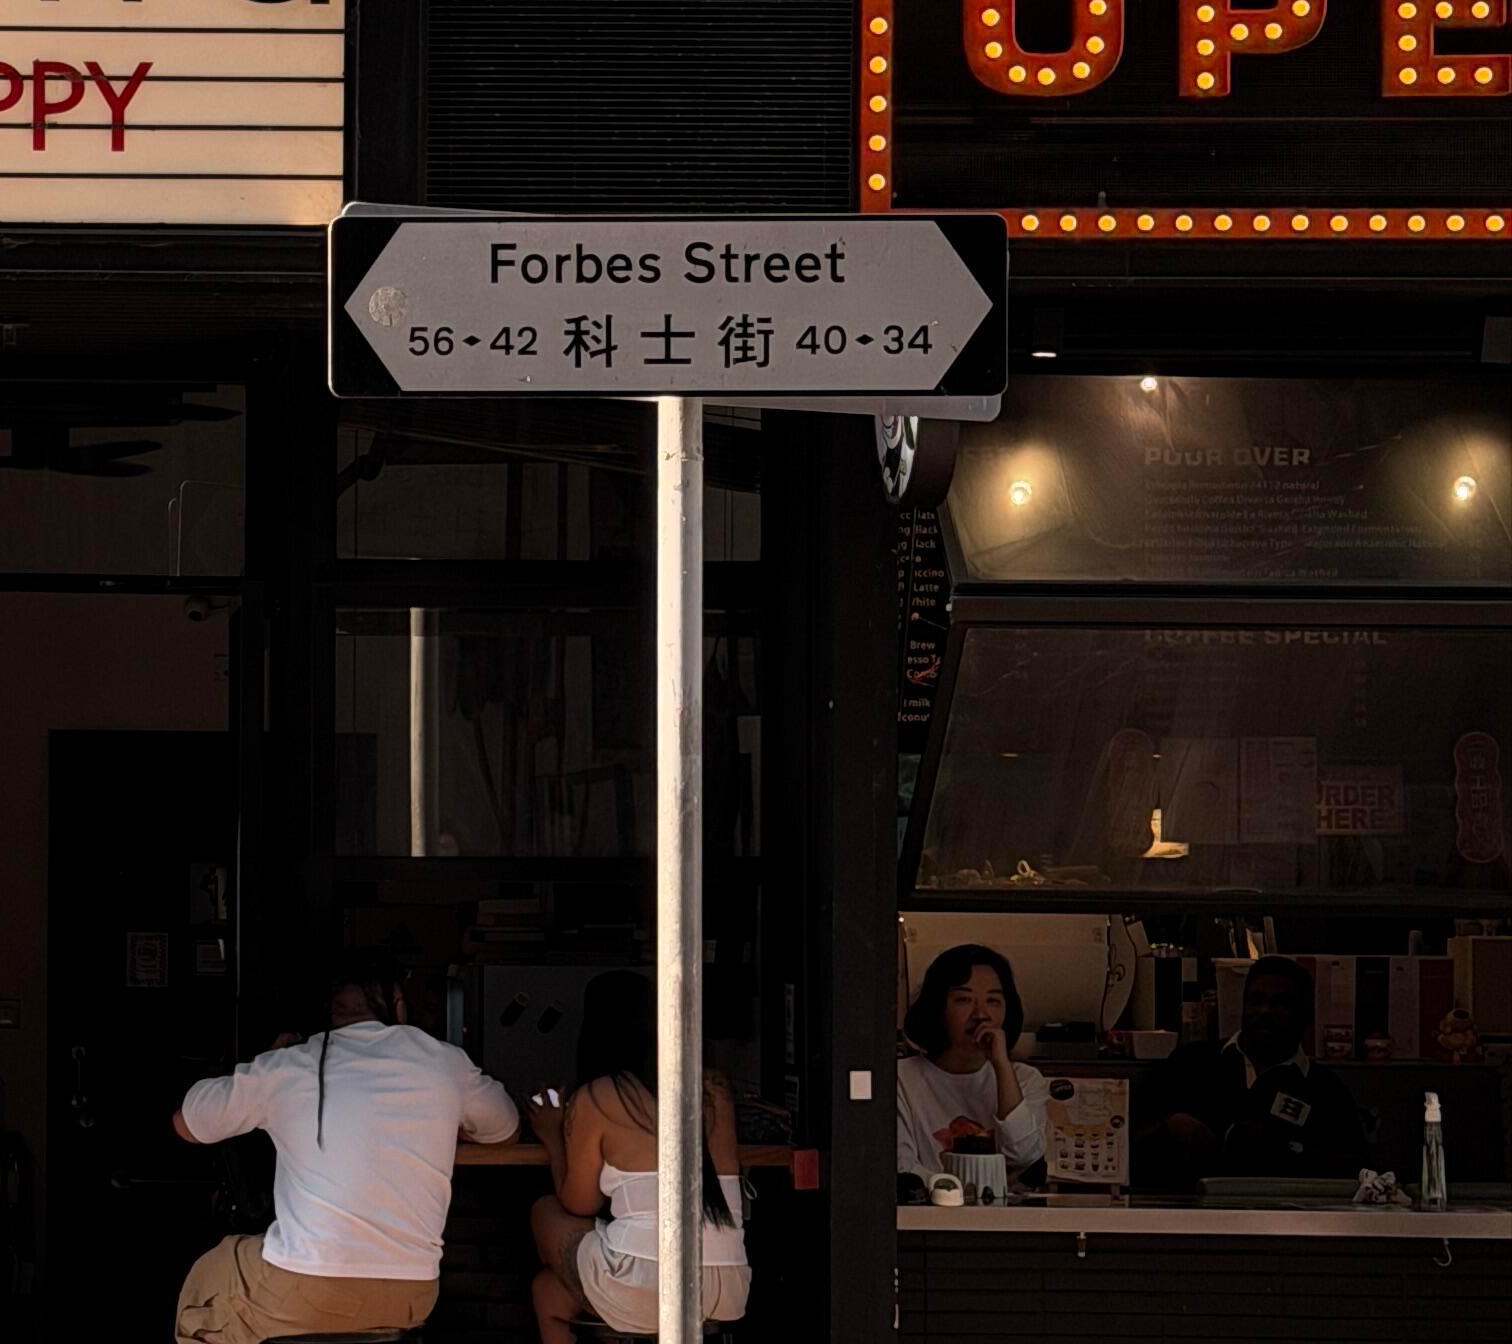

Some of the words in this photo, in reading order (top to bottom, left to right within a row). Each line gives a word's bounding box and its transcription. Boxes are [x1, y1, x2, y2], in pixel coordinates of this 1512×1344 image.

[490, 241, 662, 284] Forbes
[683, 241, 847, 284] Street
[562, 313, 776, 370] 科士街
[1317, 809, 1388, 830] HERE
